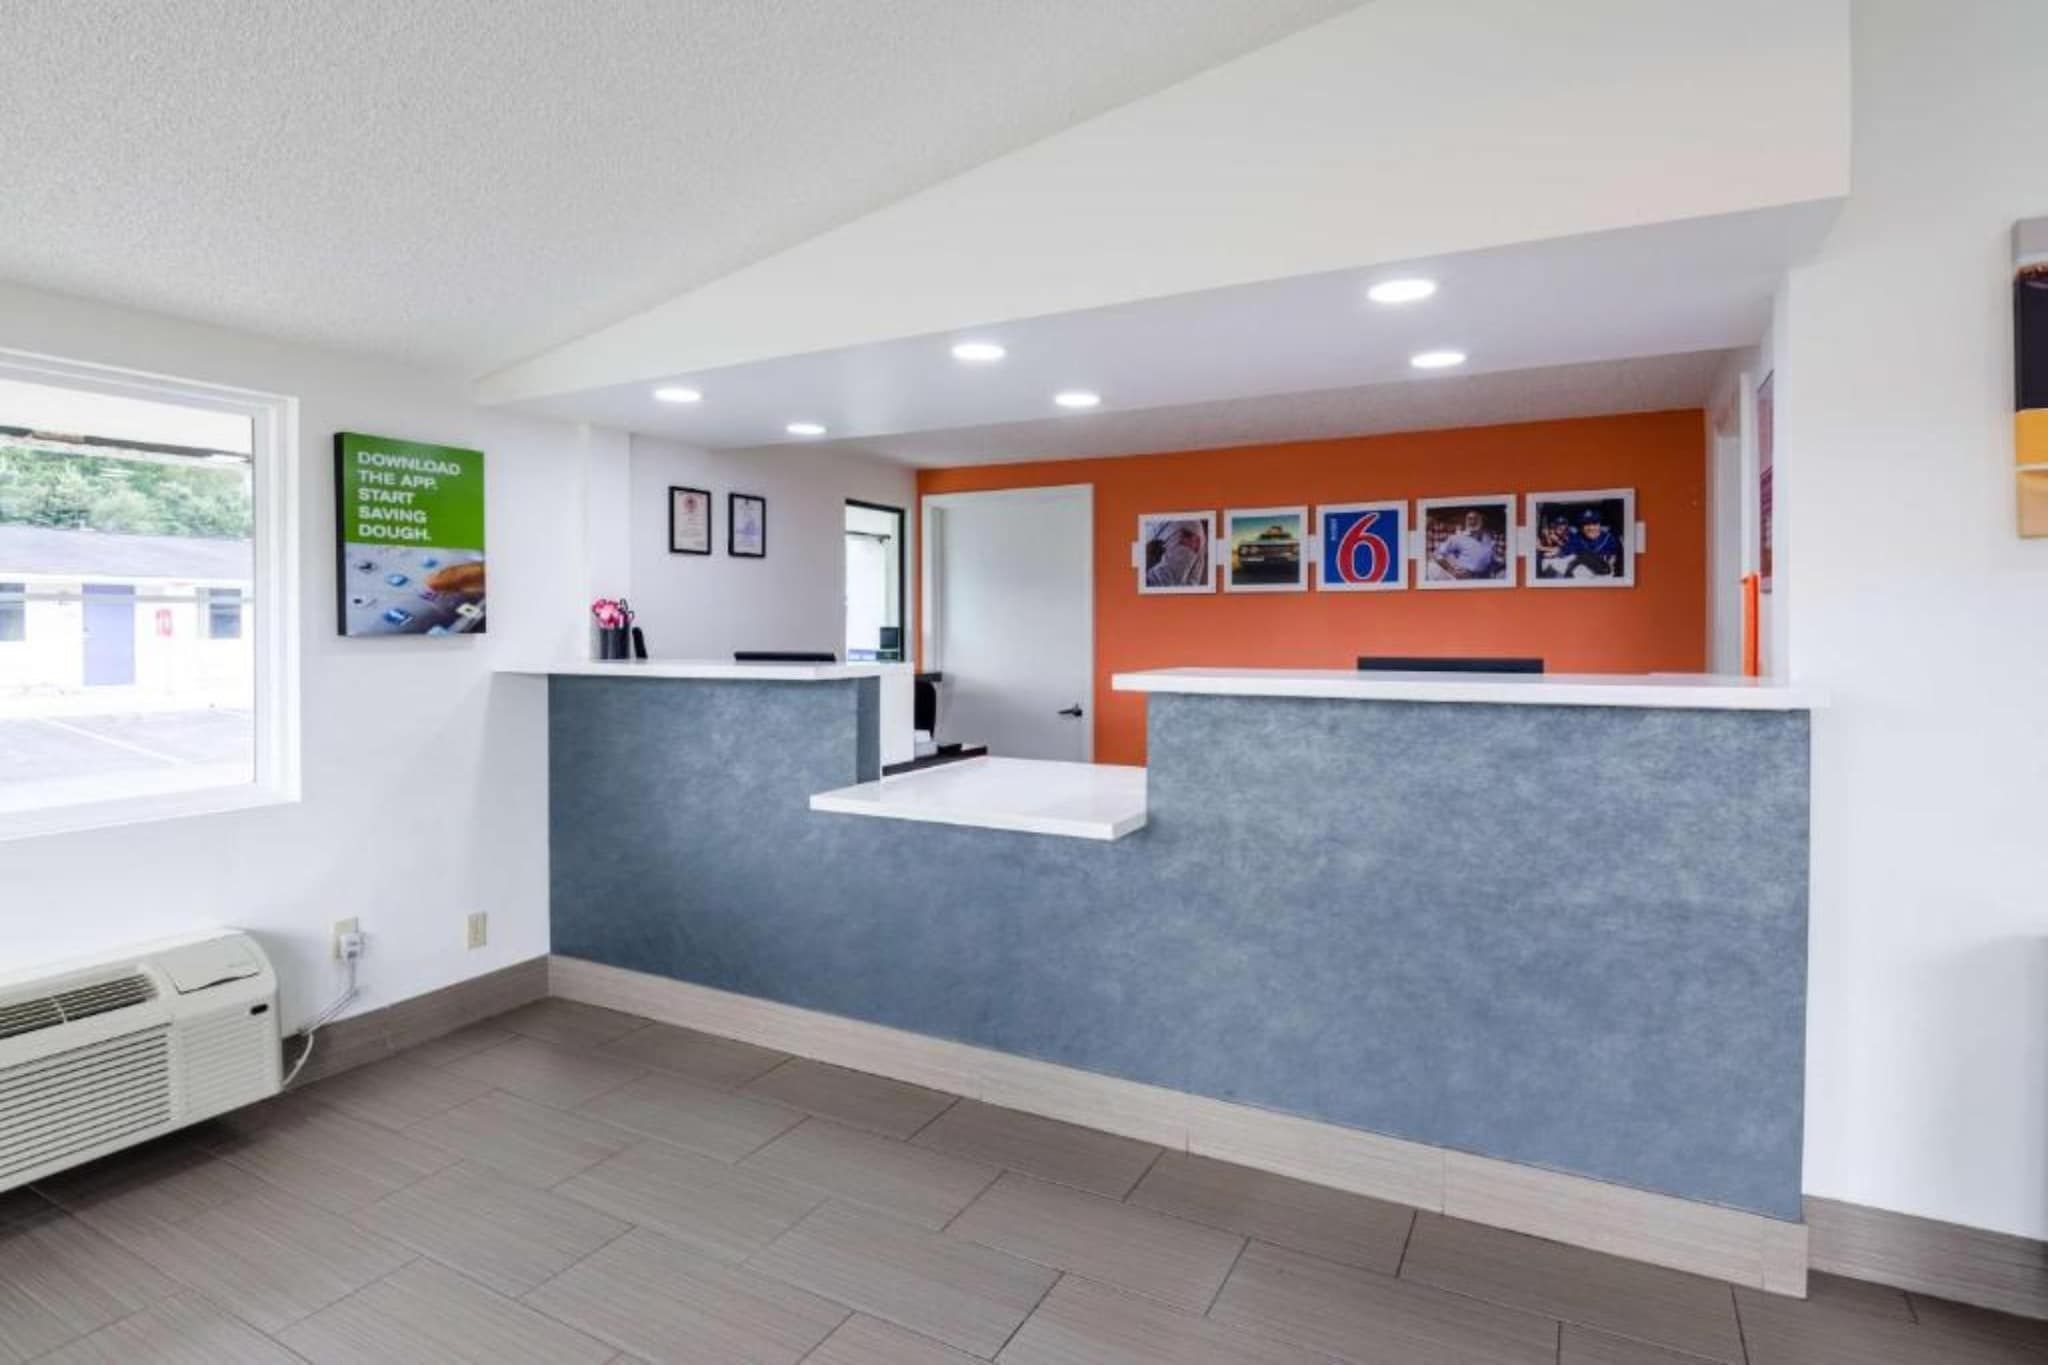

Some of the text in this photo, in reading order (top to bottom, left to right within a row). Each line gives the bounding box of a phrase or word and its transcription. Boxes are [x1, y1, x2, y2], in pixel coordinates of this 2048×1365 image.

[358, 451, 461, 476] DOWNLOAD
[358, 470, 438, 490] THE APP.
[358, 487, 415, 504] START
[358, 505, 427, 524] SAVING
[358, 524, 432, 541] DOUGH.
[1336, 512, 1390, 584] 6
